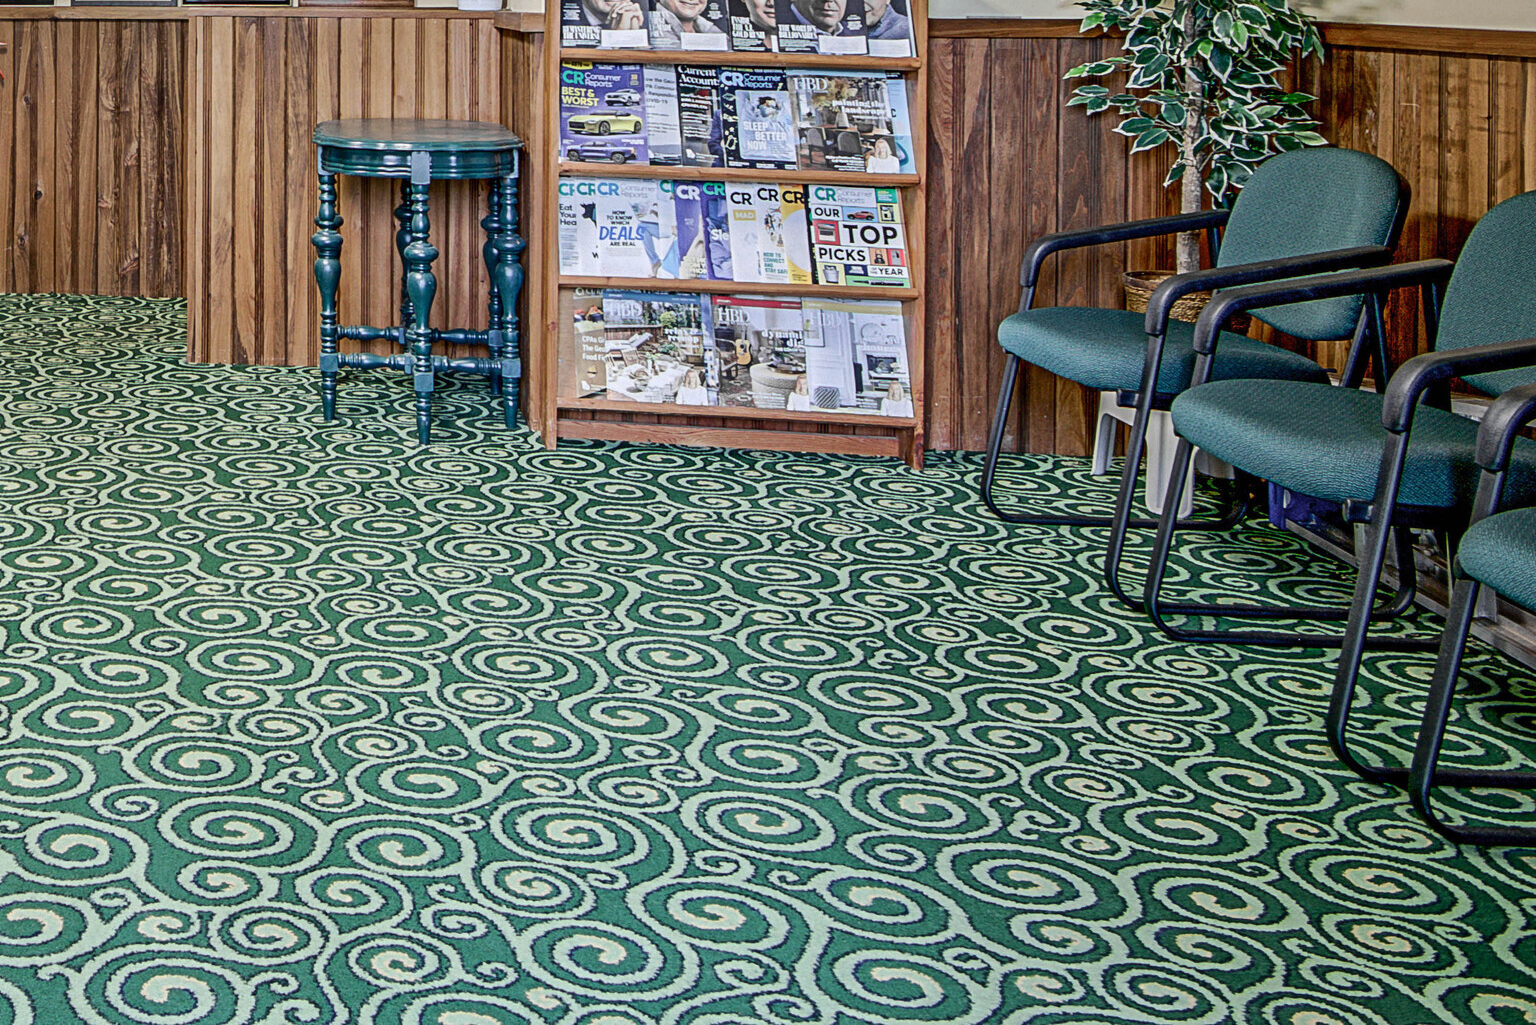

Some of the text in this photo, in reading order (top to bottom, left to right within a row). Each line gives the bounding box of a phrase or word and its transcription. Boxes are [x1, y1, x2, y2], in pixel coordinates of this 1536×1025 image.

[677, 65, 717, 76] Current
[562, 70, 622, 85] CR Consumer
[584, 79, 613, 88] Reports
[720, 71, 782, 87] CR Consumer
[744, 79, 774, 89] Reports
[561, 86, 595, 98] BEST &
[561, 95, 600, 107] WORST
[743, 120, 769, 131] SLEEP
[754, 131, 787, 141] BETTER
[747, 140, 767, 150] NOW
[597, 182, 657, 196] CR Consumer
[676, 184, 701, 200] CR
[702, 182, 726, 196] CR
[757, 187, 779, 202] CR
[814, 186, 837, 202] CR
[836, 188, 873, 198] Consumer
[730, 191, 752, 205] CR
[781, 190, 805, 204] CR
[559, 203, 573, 212] Eat
[814, 207, 840, 218] OUR
[734, 211, 754, 220] MAD
[599, 225, 646, 241] DEALS
[711, 229, 729, 241] Sle
[842, 223, 898, 245] TOP
[818, 246, 866, 262] PICKS
[878, 267, 904, 275] YEAR
[761, 329, 803, 340] dynami
